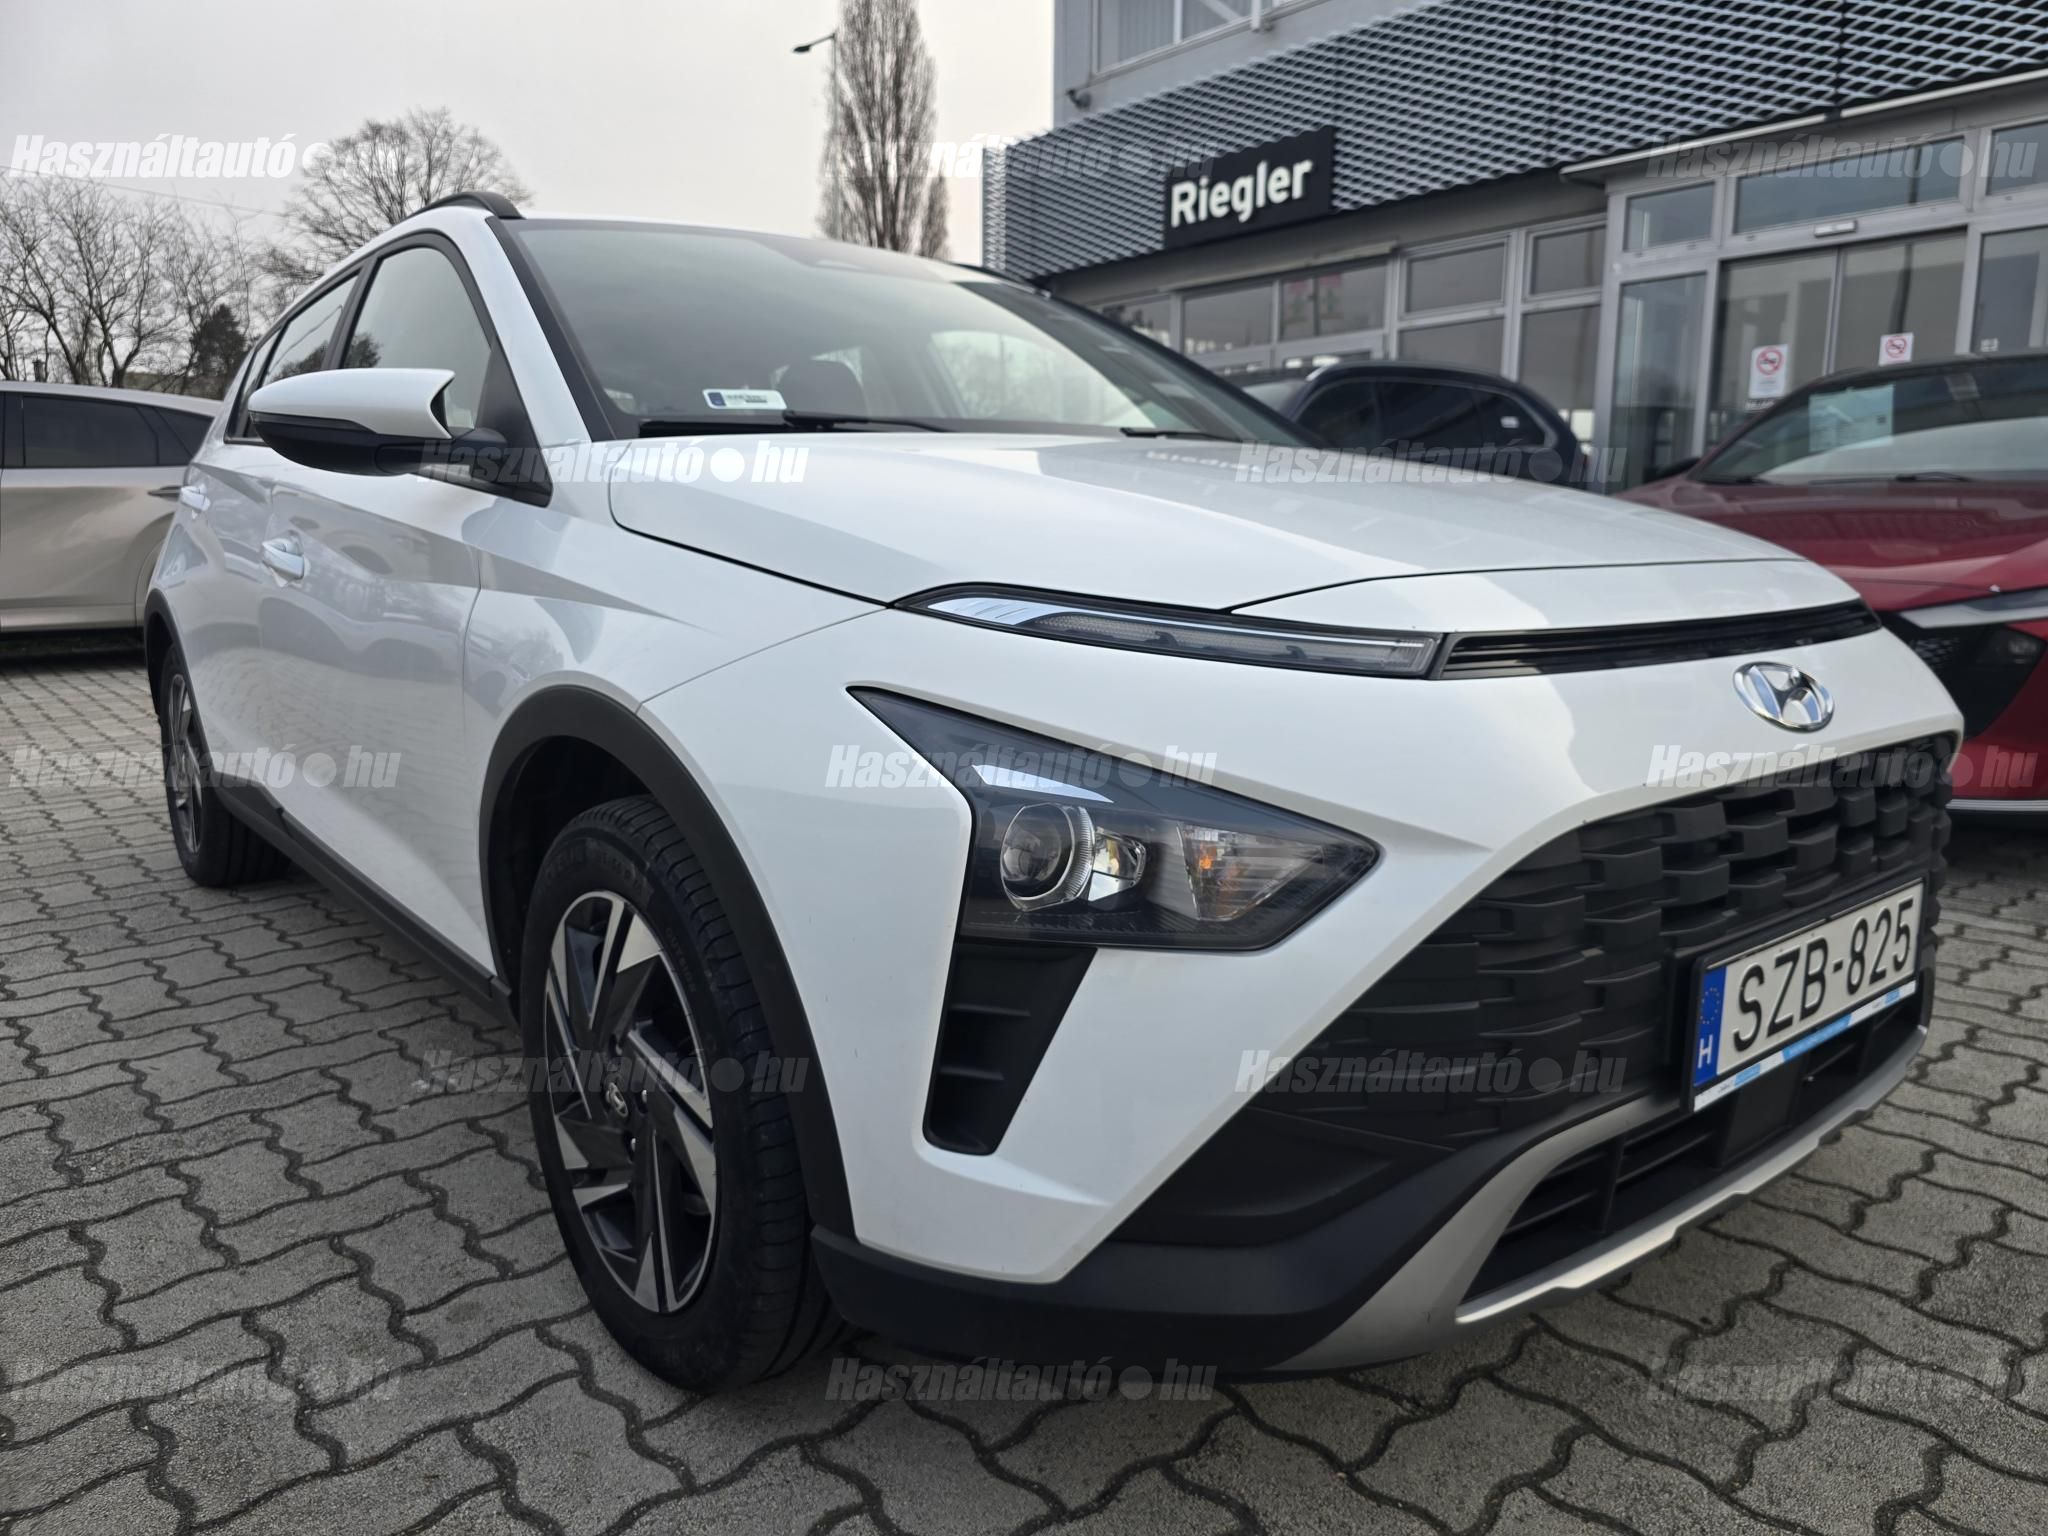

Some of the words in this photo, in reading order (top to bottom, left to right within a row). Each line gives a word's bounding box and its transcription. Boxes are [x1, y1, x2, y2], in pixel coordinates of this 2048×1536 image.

[1170, 159, 1314, 229] Riegler
[1732, 897, 1914, 1053] SZB-825
[1697, 1034, 1713, 1069] H
